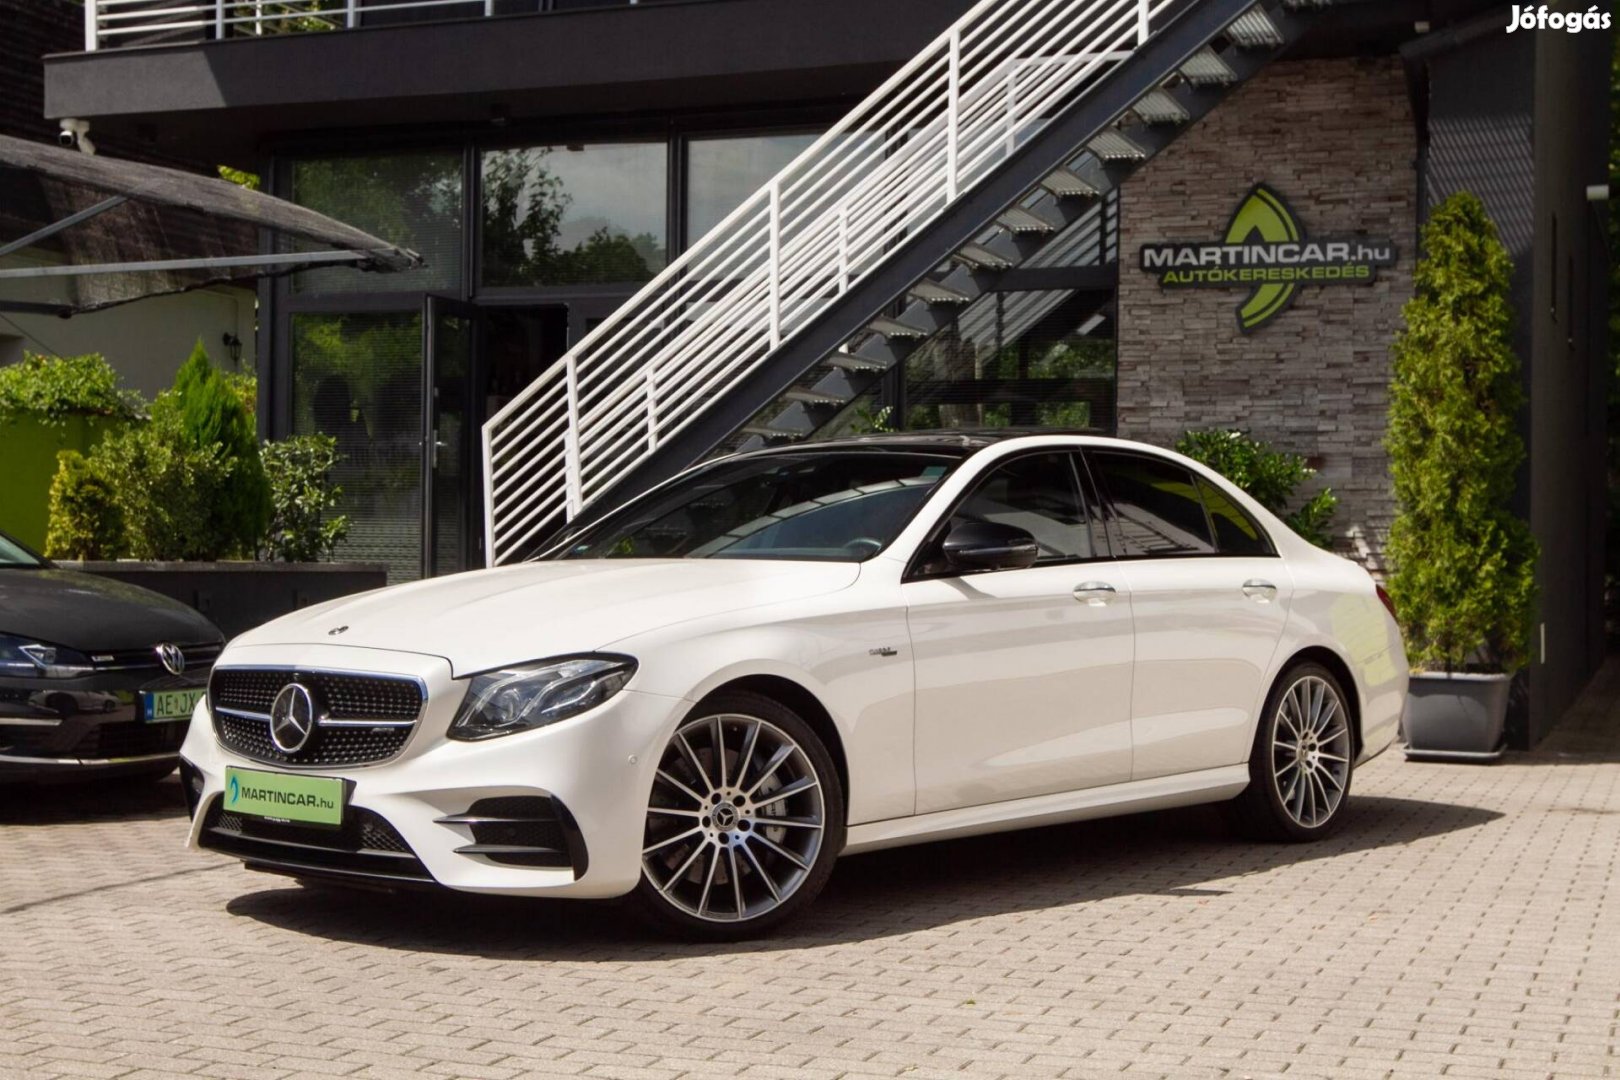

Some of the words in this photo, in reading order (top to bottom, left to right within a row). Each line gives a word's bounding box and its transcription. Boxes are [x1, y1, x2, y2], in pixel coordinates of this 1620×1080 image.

[1144, 243, 1390, 267] MARTINCAR.hu
[1163, 263, 1370, 283] AUTÓKERESKEDÉS
[241, 786, 334, 809] MARTINCAR.hu
